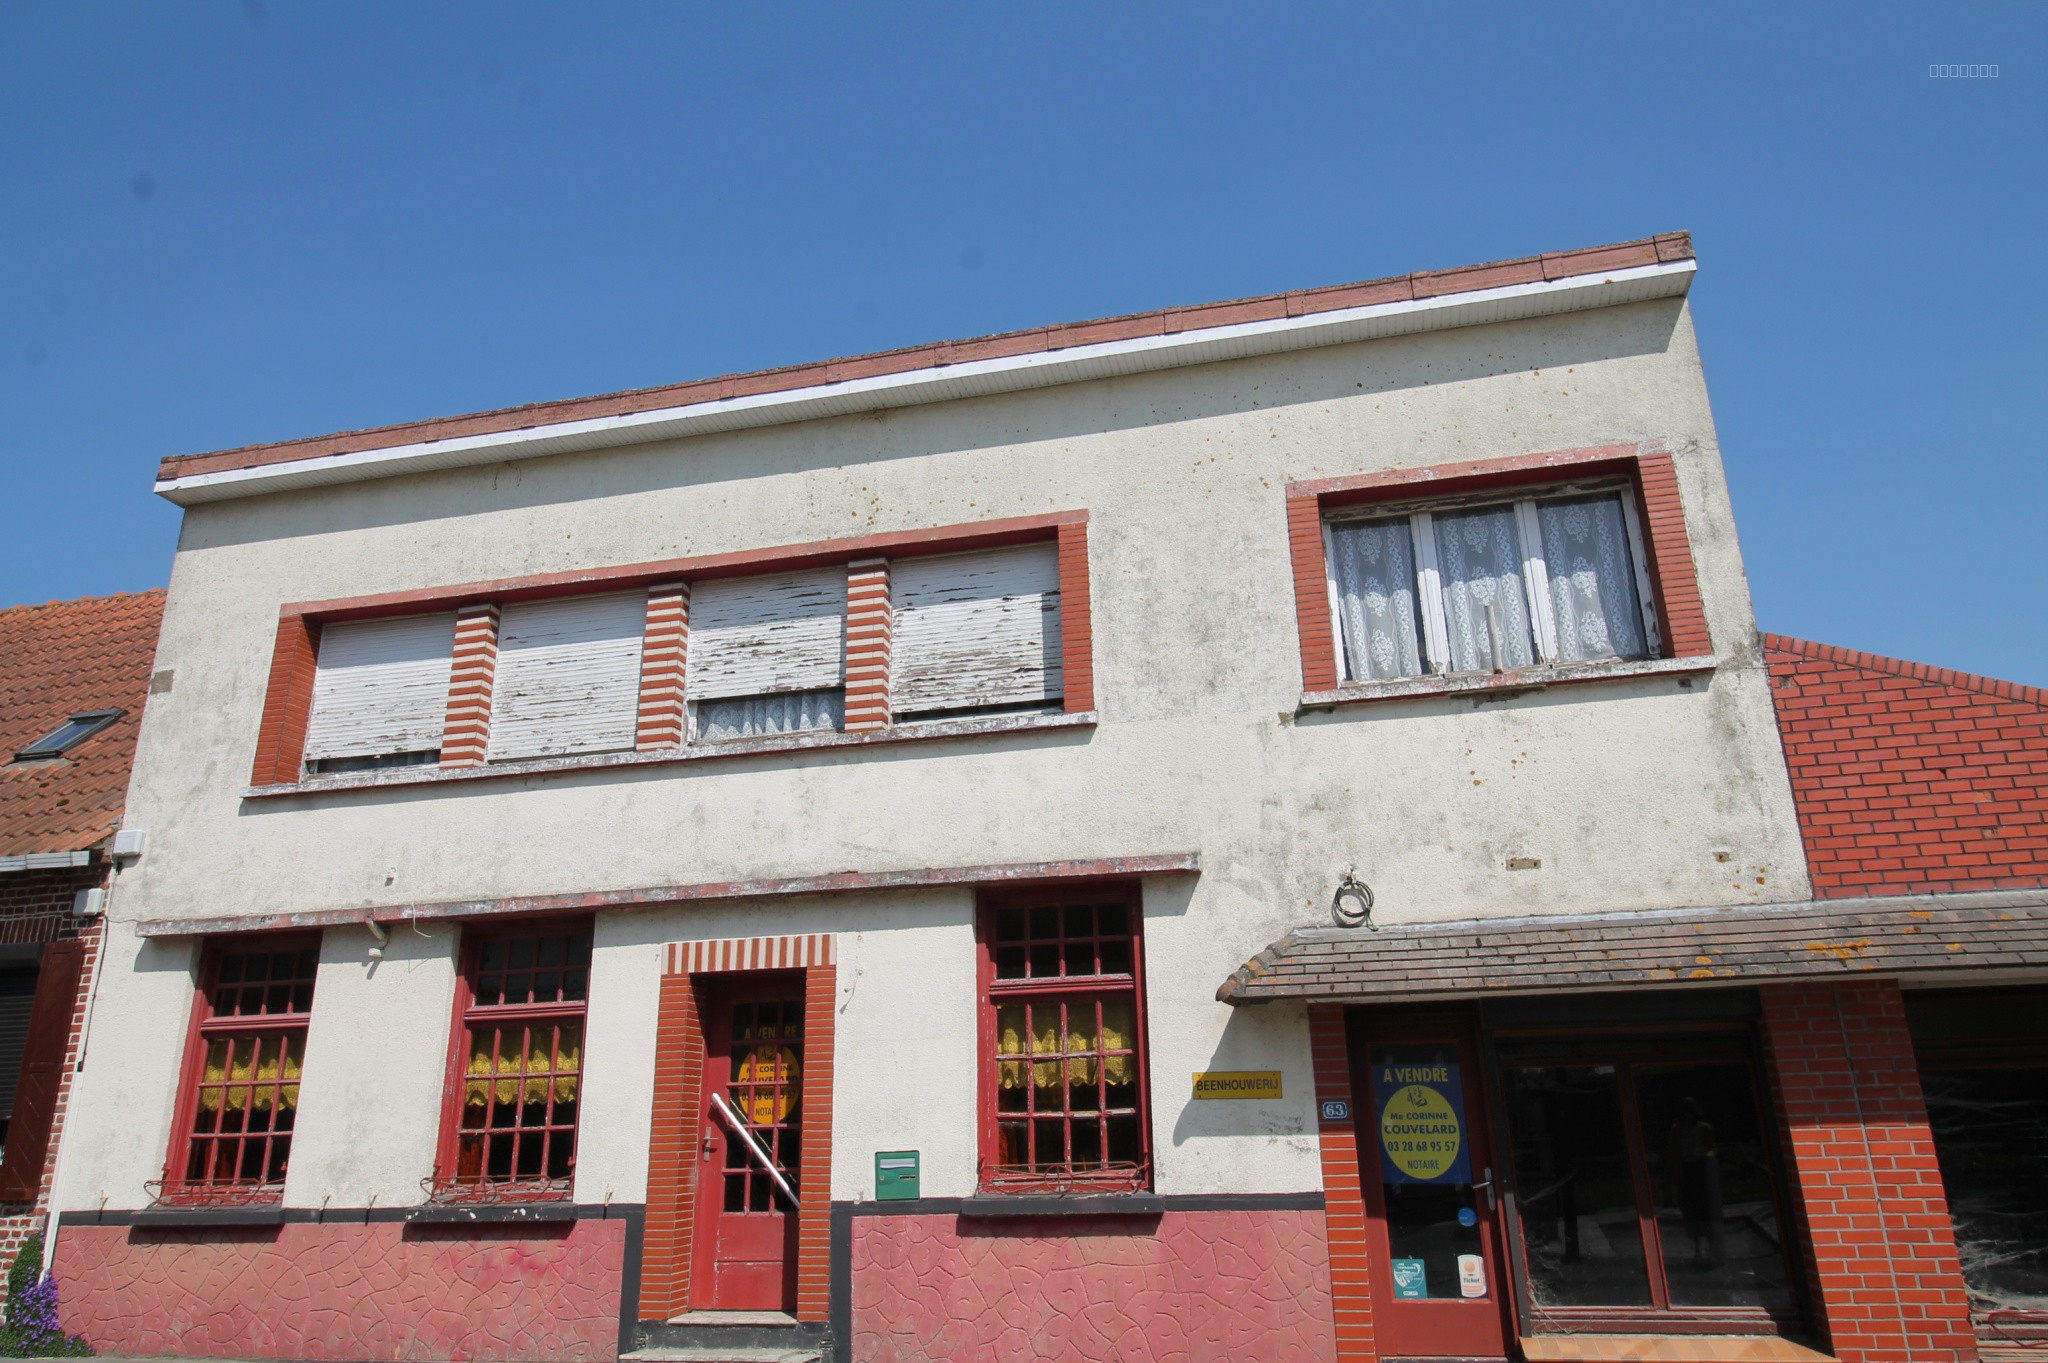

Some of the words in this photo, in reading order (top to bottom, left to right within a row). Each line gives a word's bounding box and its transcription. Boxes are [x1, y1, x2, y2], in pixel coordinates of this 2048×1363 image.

[1383, 1067, 1393, 1083] A
[1395, 1067, 1449, 1083] VENDRE
[1196, 1078, 1279, 1091] BEENHOUWERIJ
[1325, 1104, 1345, 1116] 63
[1390, 1112, 1404, 1120] Me
[1406, 1112, 1449, 1120] CORINNE
[1384, 1124, 1457, 1134] COUVELARD
[1387, 1141, 1400, 1152] 03
[1402, 1141, 1414, 1152] 28
[1416, 1141, 1428, 1152] 68
[1430, 1141, 1442, 1152] 95
[1445, 1141, 1456, 1152] 57
[1407, 1160, 1440, 1170] NOTAIRE
